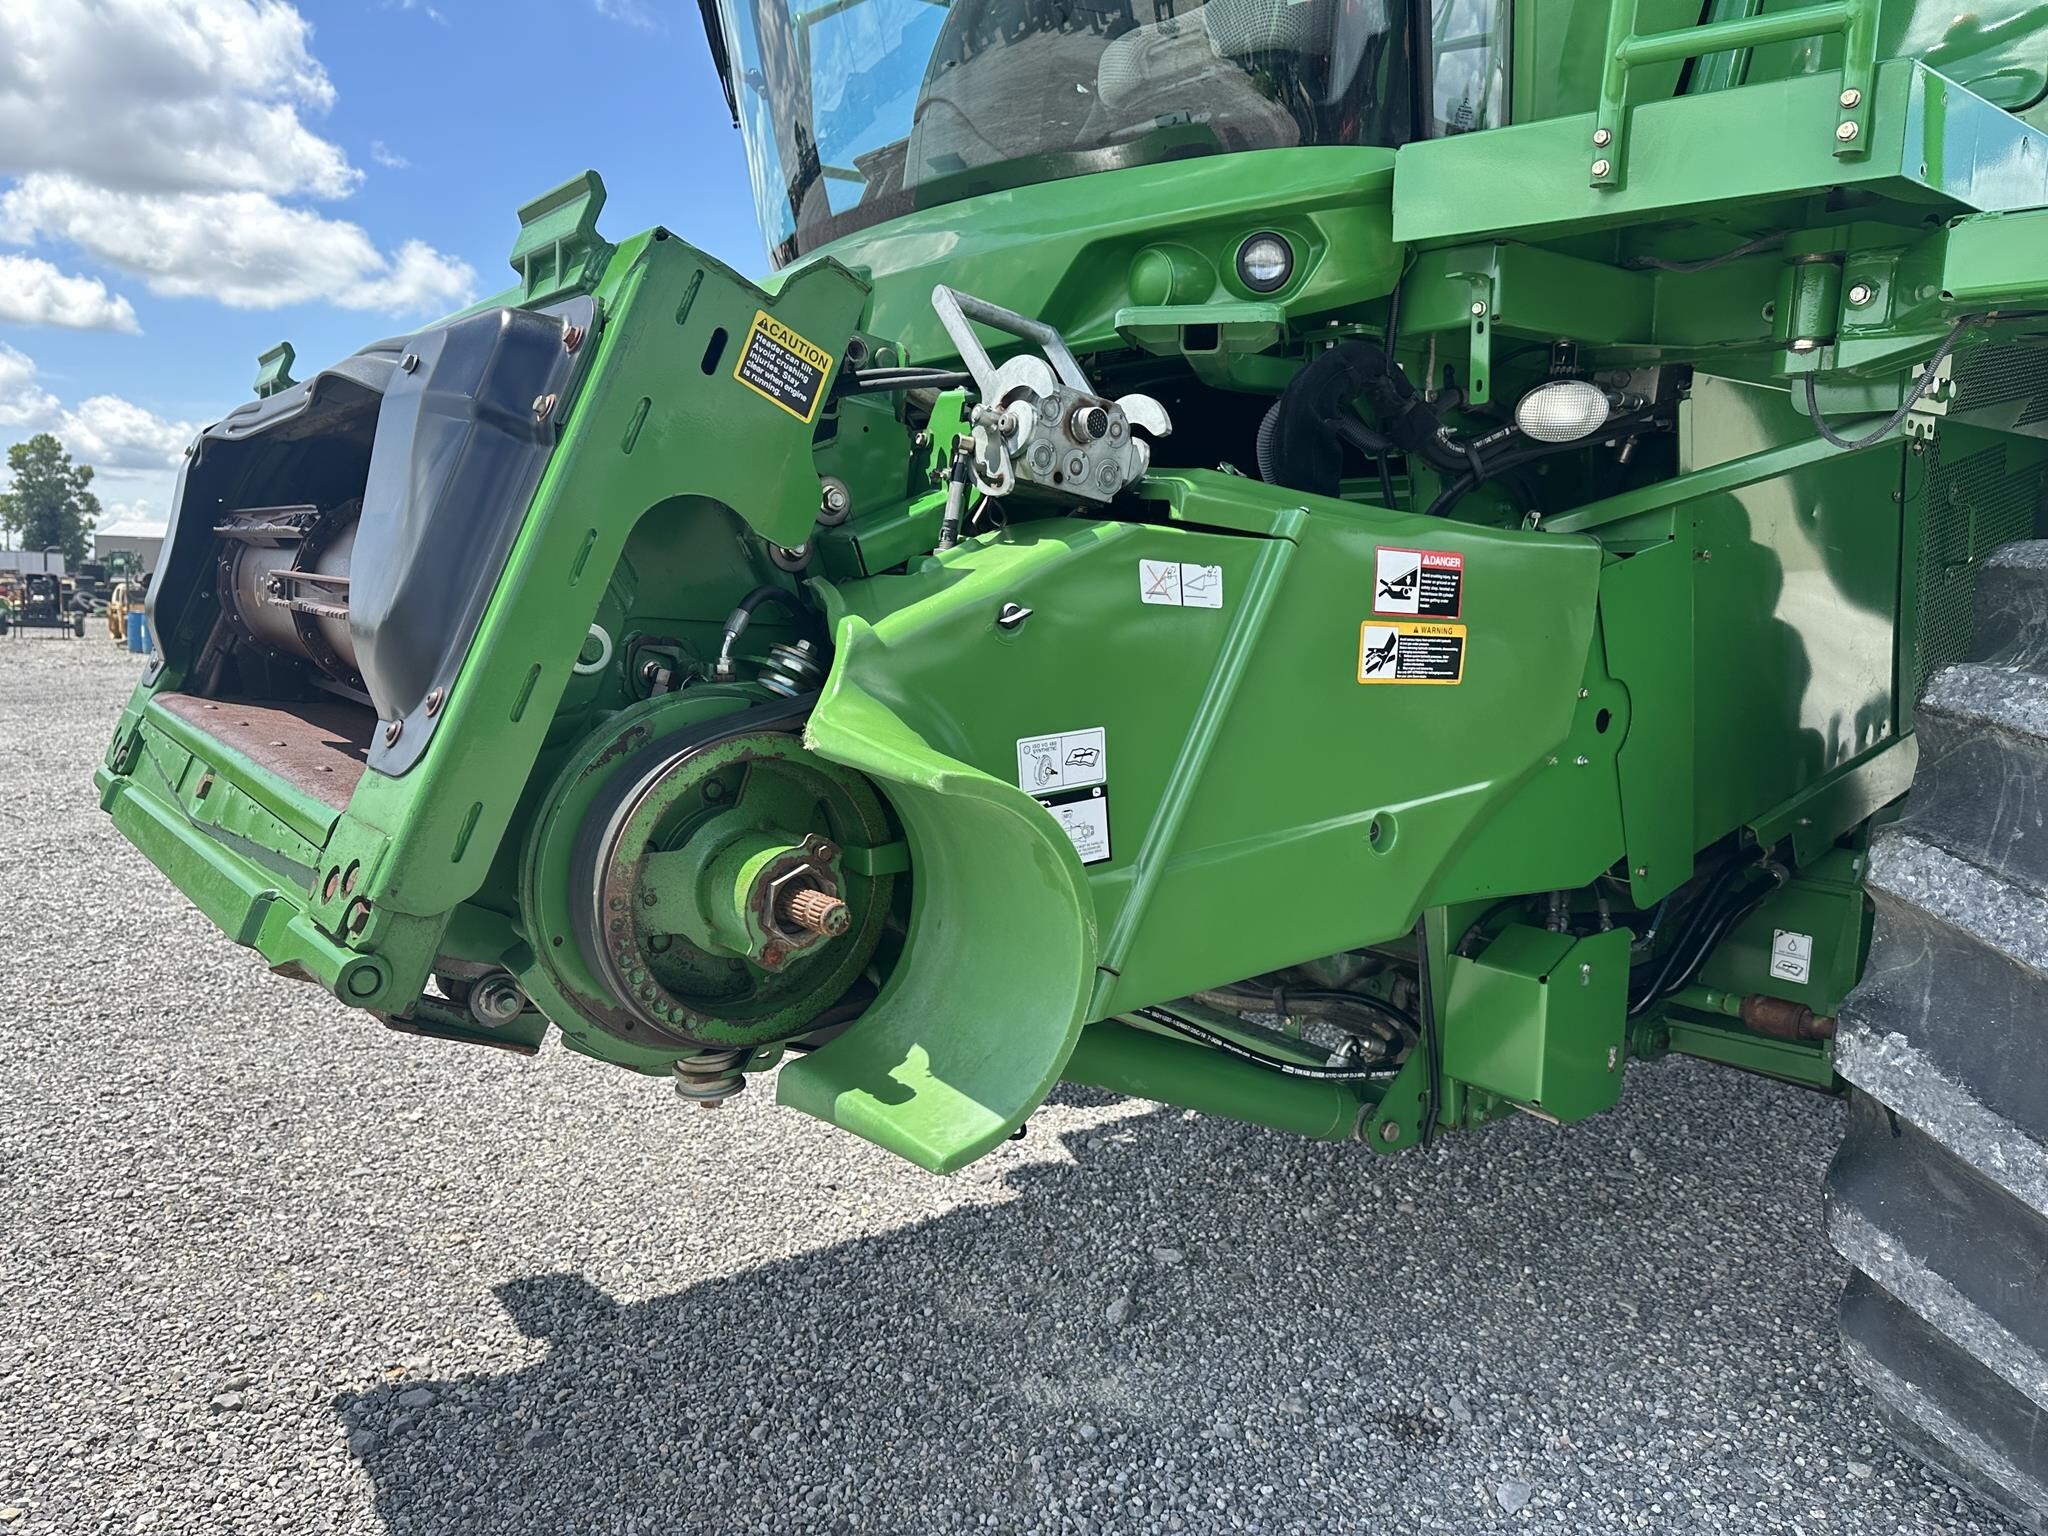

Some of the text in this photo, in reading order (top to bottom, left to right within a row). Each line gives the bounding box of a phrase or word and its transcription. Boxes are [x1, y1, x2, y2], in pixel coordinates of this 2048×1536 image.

[756, 333, 814, 376] Header can tilt.
[770, 323, 828, 369] CAUTION
[752, 342, 809, 384] Avoid crushing
[782, 370, 800, 387] Stay
[746, 360, 807, 402] clear when engine
[751, 373, 781, 397] running.
[1429, 555, 1461, 568] DANGER
[1421, 626, 1453, 635] WARNING
